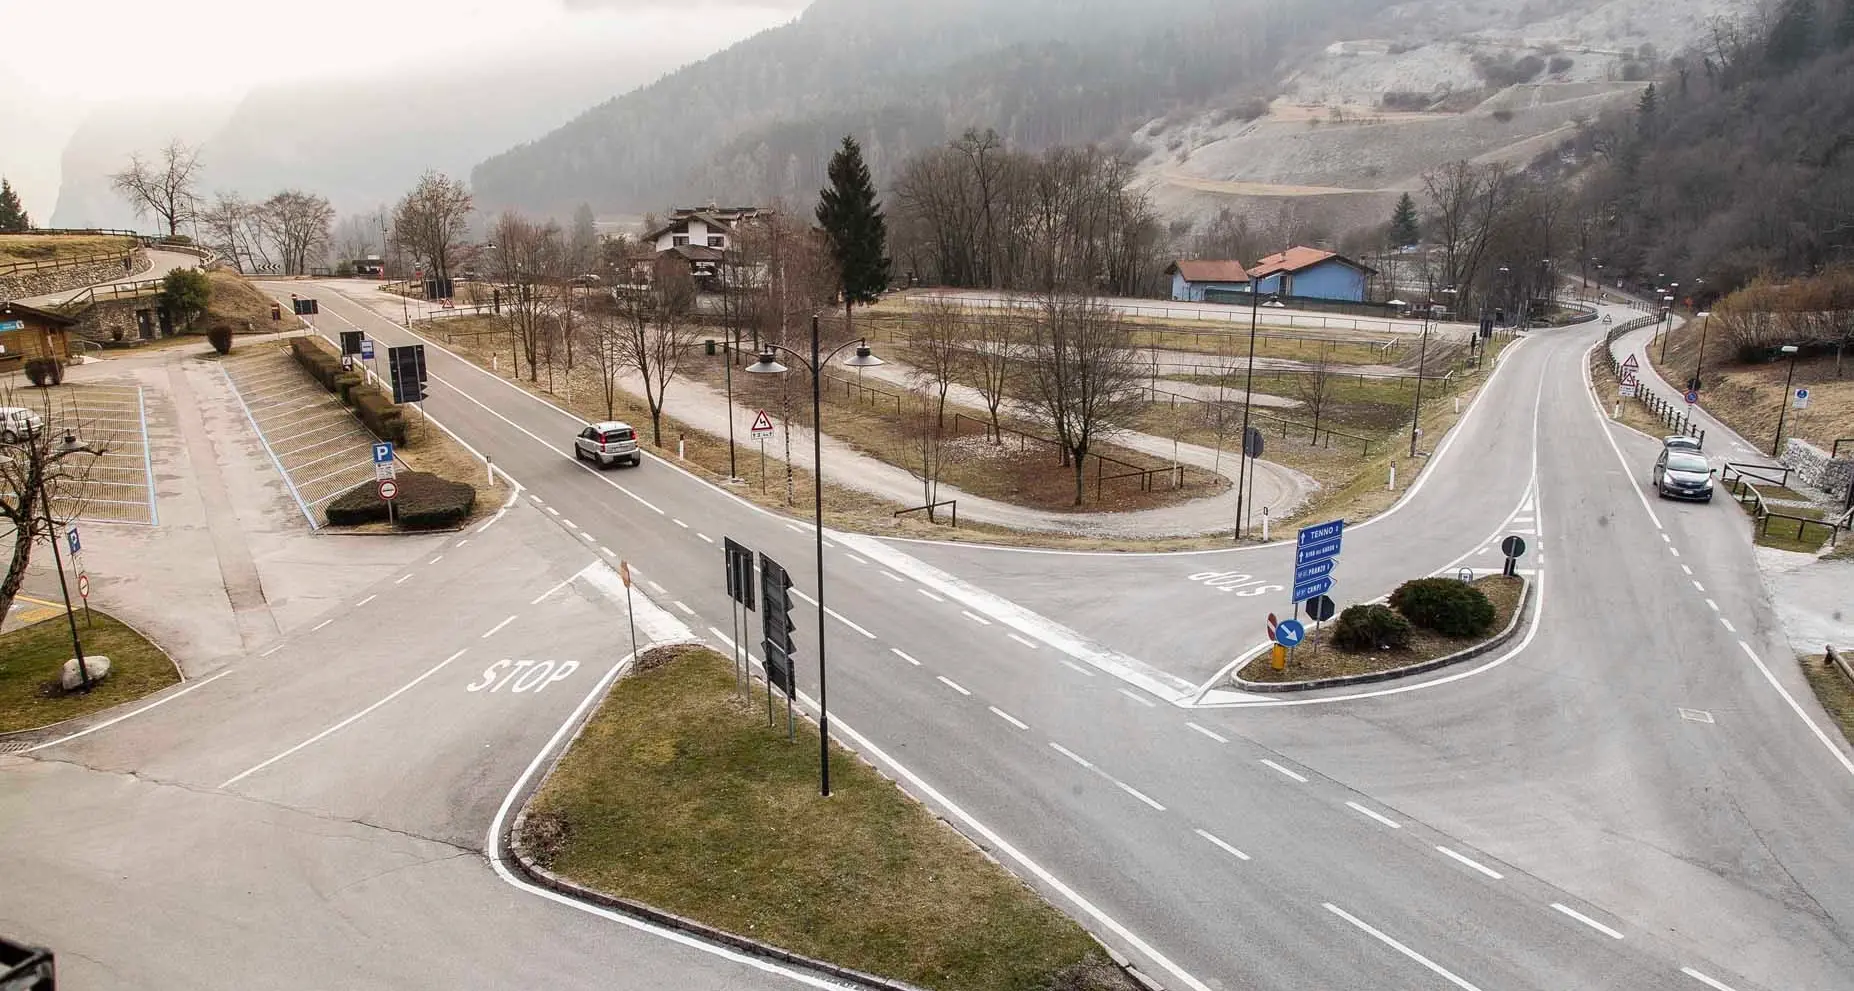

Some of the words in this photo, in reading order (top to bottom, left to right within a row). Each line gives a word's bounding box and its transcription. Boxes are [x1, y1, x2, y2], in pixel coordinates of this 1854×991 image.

[376, 446, 389, 461] P
[1311, 526, 1334, 539] TENNO
[1188, 571, 1284, 597] STOP
[466, 659, 580, 693] STOP
